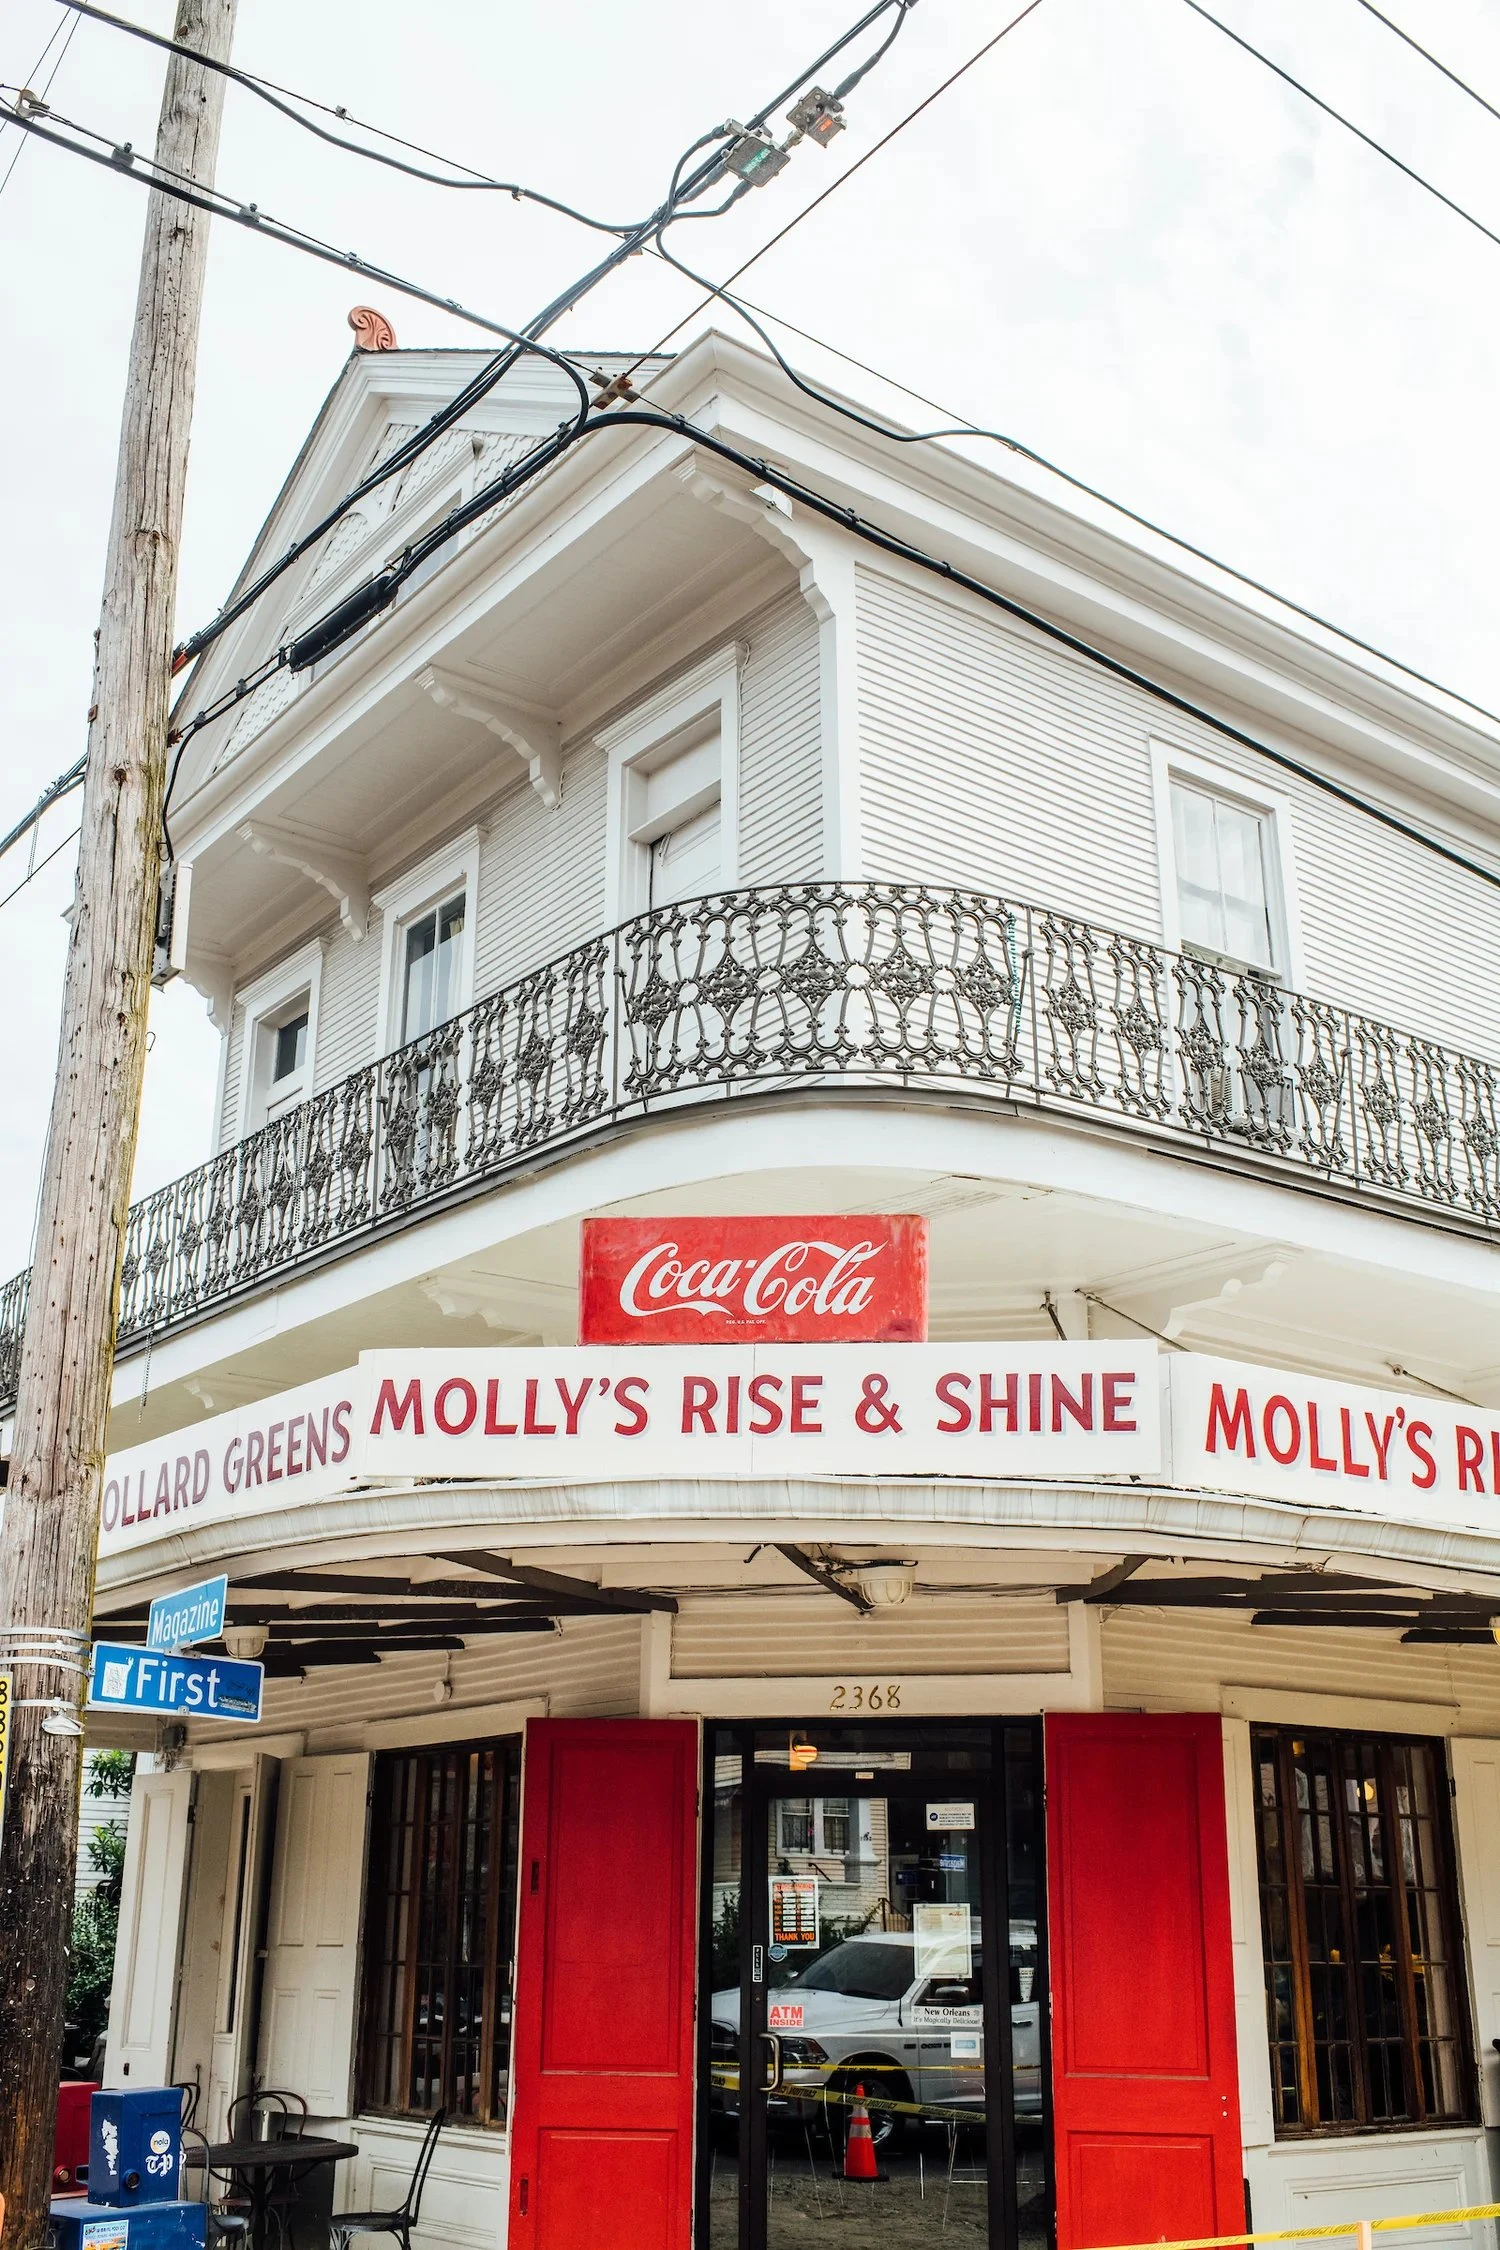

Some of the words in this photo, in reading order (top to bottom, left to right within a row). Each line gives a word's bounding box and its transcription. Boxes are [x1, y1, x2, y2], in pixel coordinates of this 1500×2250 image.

[619, 1239, 889, 1317] Coca-Cola
[370, 1377, 650, 1436] MOLLY'S
[681, 1375, 823, 1434] RISE
[855, 1373, 903, 1433] &
[935, 1372, 1137, 1432] SHINE
[223, 1401, 352, 1494] GREENS
[1205, 1383, 1437, 1489] MOLLY'S
[151, 1596, 219, 1645] Magazine
[136, 1657, 221, 1708] First
[830, 1685, 901, 1711] 2368
[775, 1933, 798, 1941] THANK
[801, 1932, 815, 1940] YOU
[770, 2006, 803, 2018] ATM
[924, 2008, 940, 2016] New
[942, 2008, 971, 2017] Orleans
[153, 2138, 169, 2147] nola
